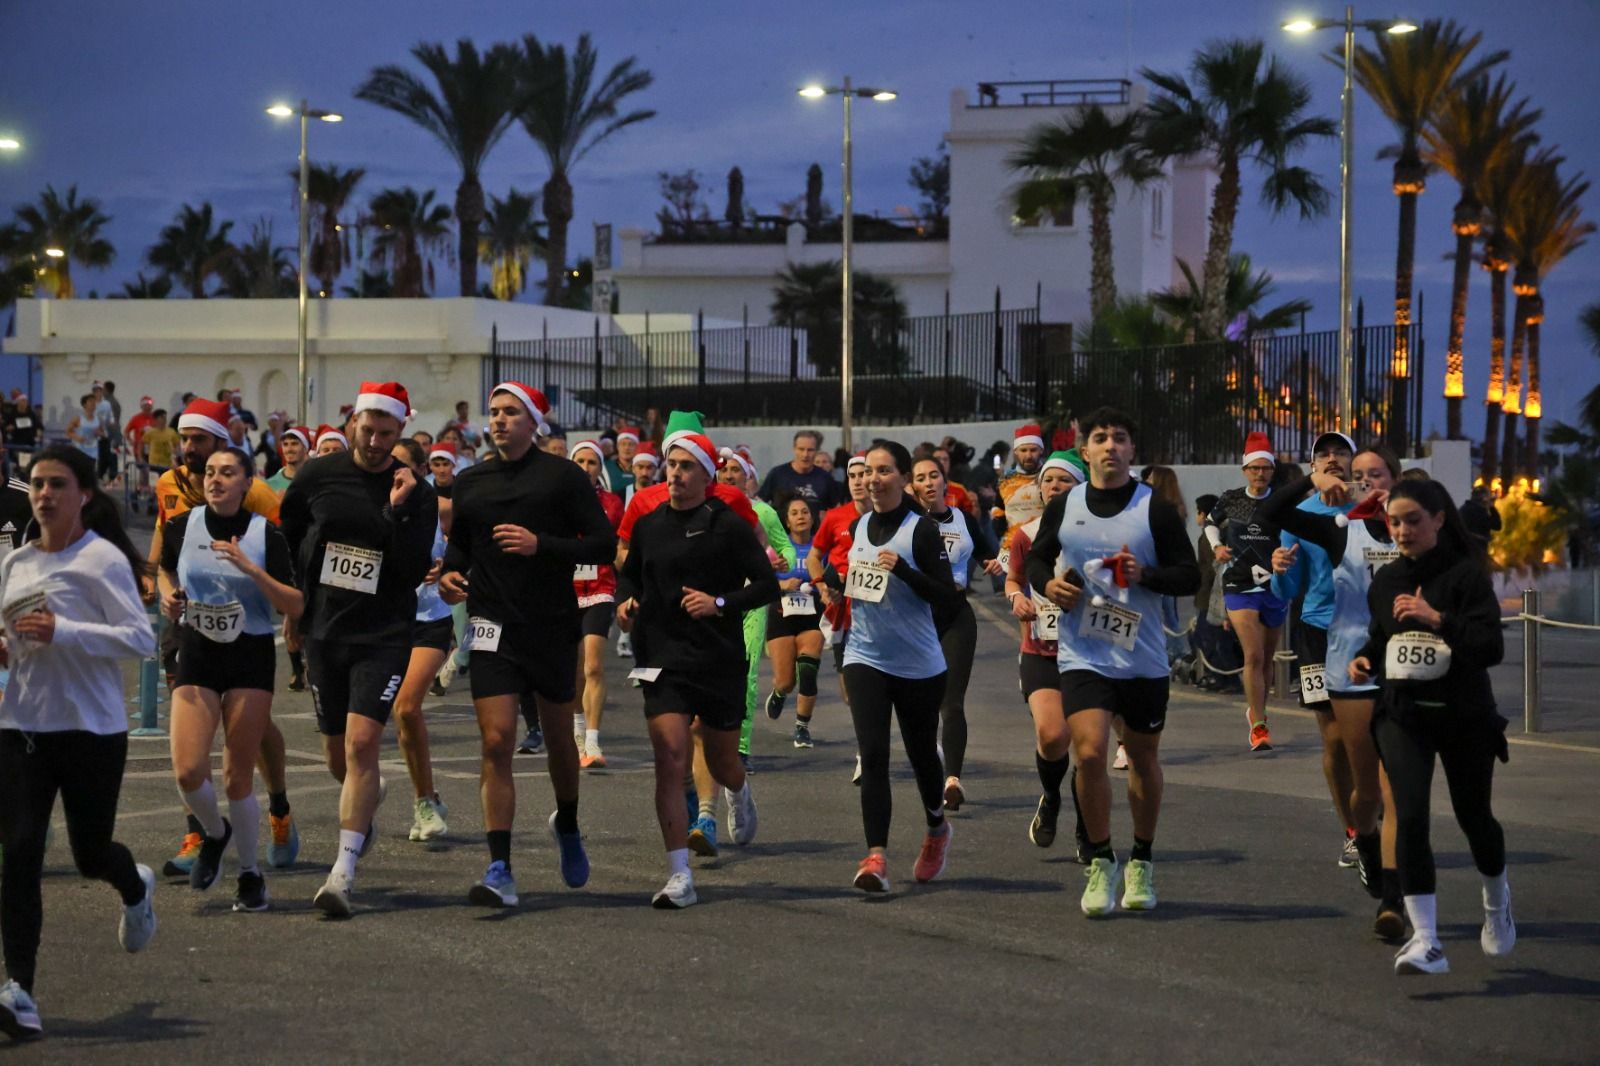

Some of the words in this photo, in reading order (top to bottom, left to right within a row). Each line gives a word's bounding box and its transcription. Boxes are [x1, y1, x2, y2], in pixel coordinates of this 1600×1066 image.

[330, 555, 375, 580] 1052
[851, 569, 884, 591] 1122
[787, 597, 808, 608] 417
[192, 613, 240, 632] 1367
[1046, 614, 1060, 629] 2
[1089, 611, 1133, 638] 1121
[1396, 645, 1437, 667] 858
